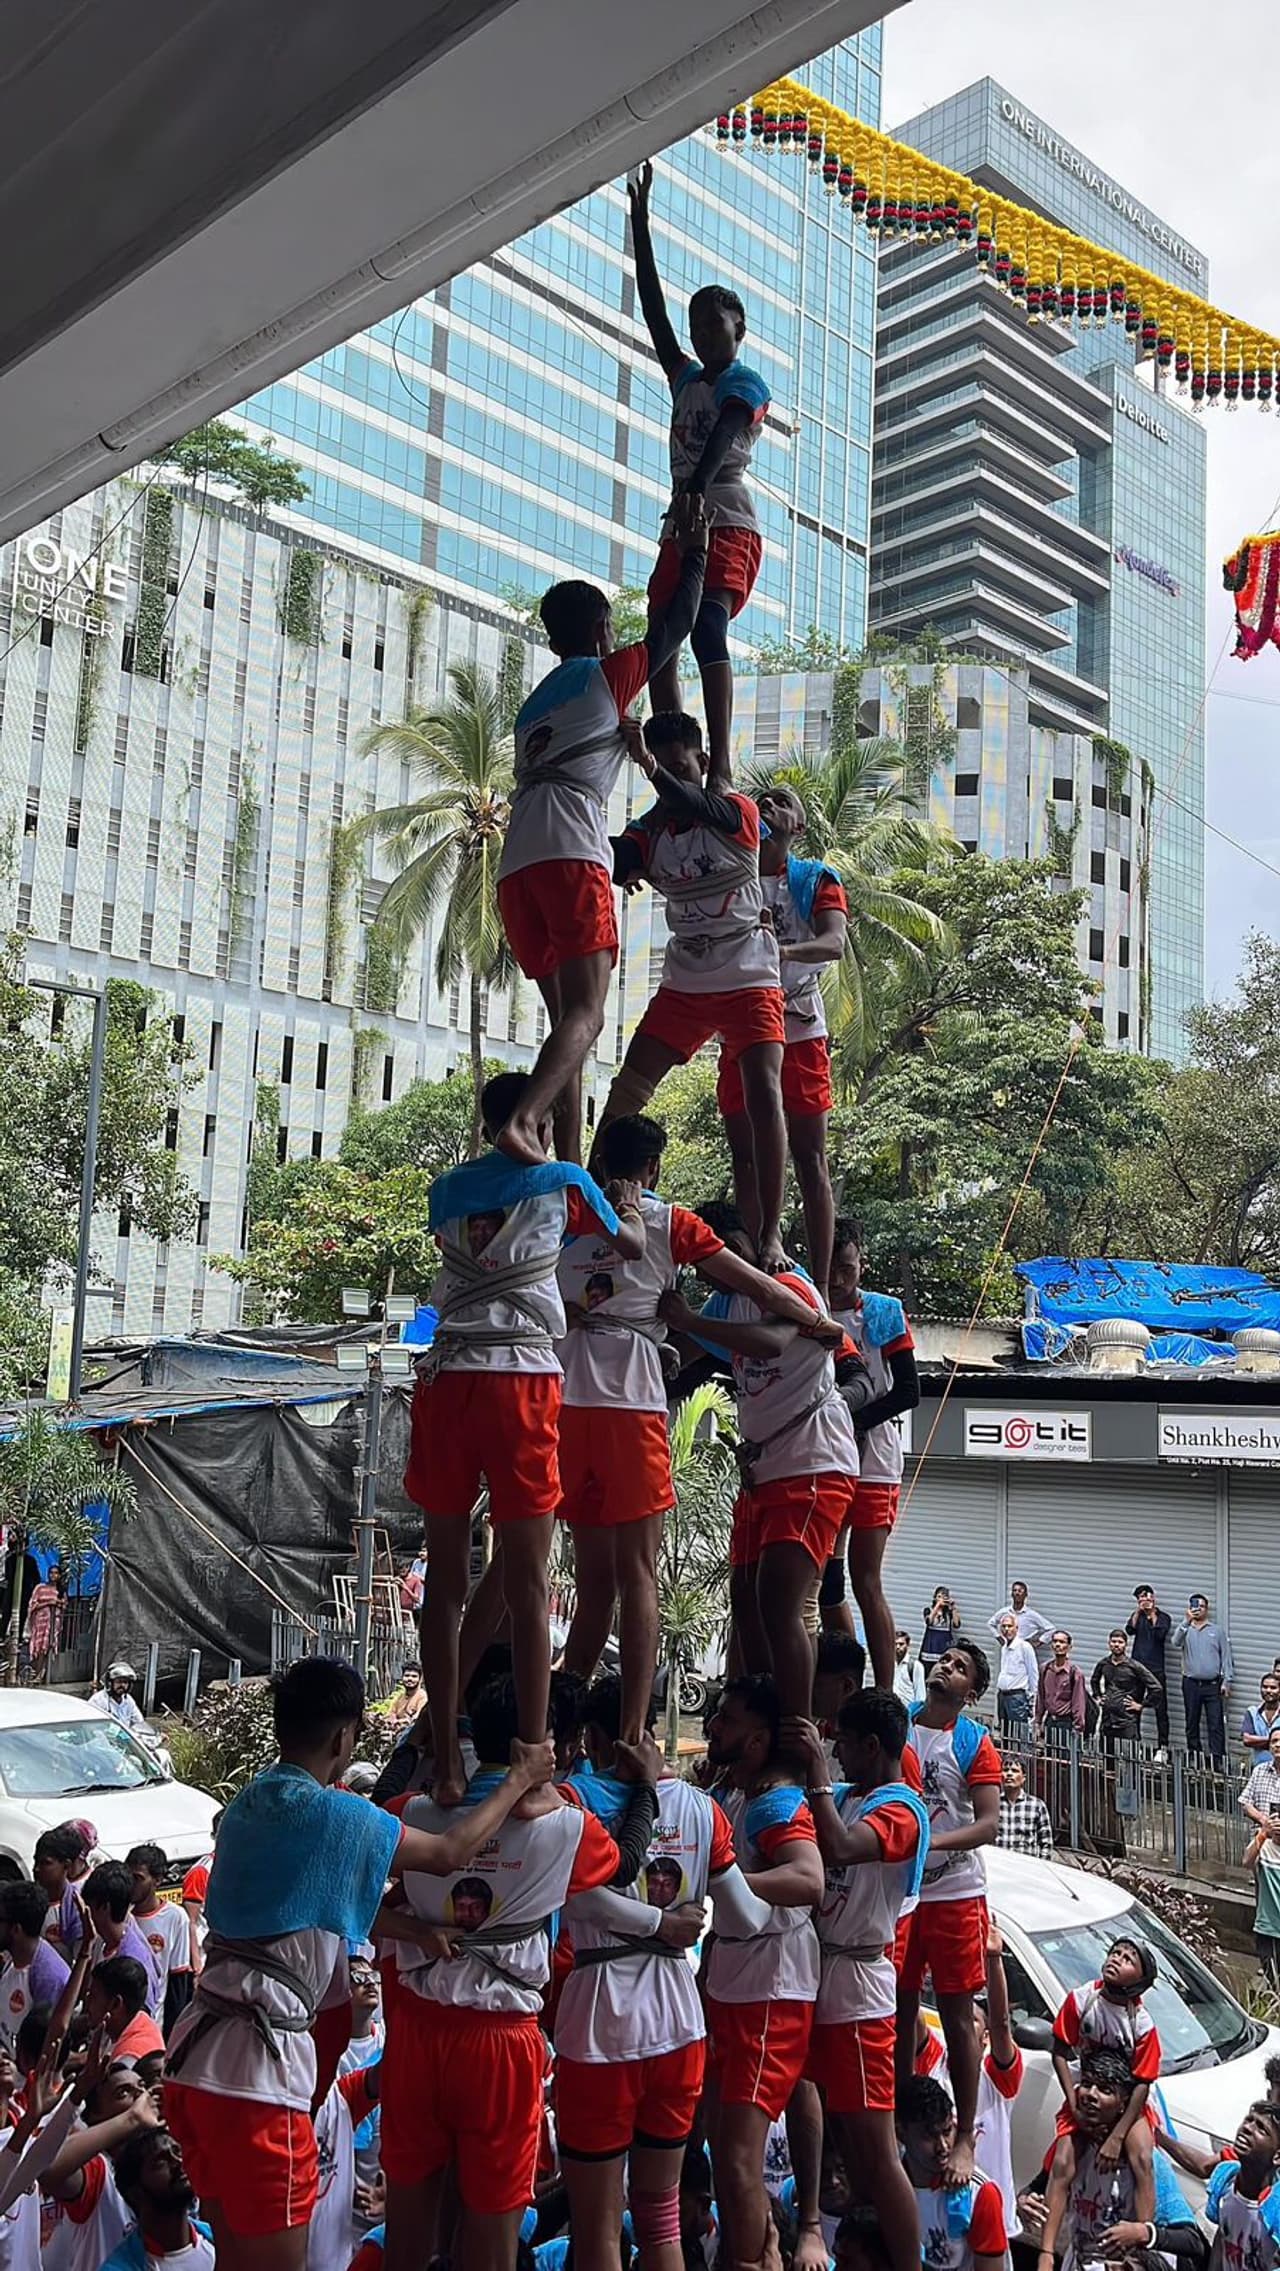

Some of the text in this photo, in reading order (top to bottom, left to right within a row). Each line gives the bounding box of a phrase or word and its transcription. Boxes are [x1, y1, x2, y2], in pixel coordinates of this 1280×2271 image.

[1002, 99, 1202, 275] ONE INTERNATIONAL CENTER
[23, 571, 95, 607] UNITY
[27, 537, 128, 602] ONE
[22, 594, 115, 639] CENTER
